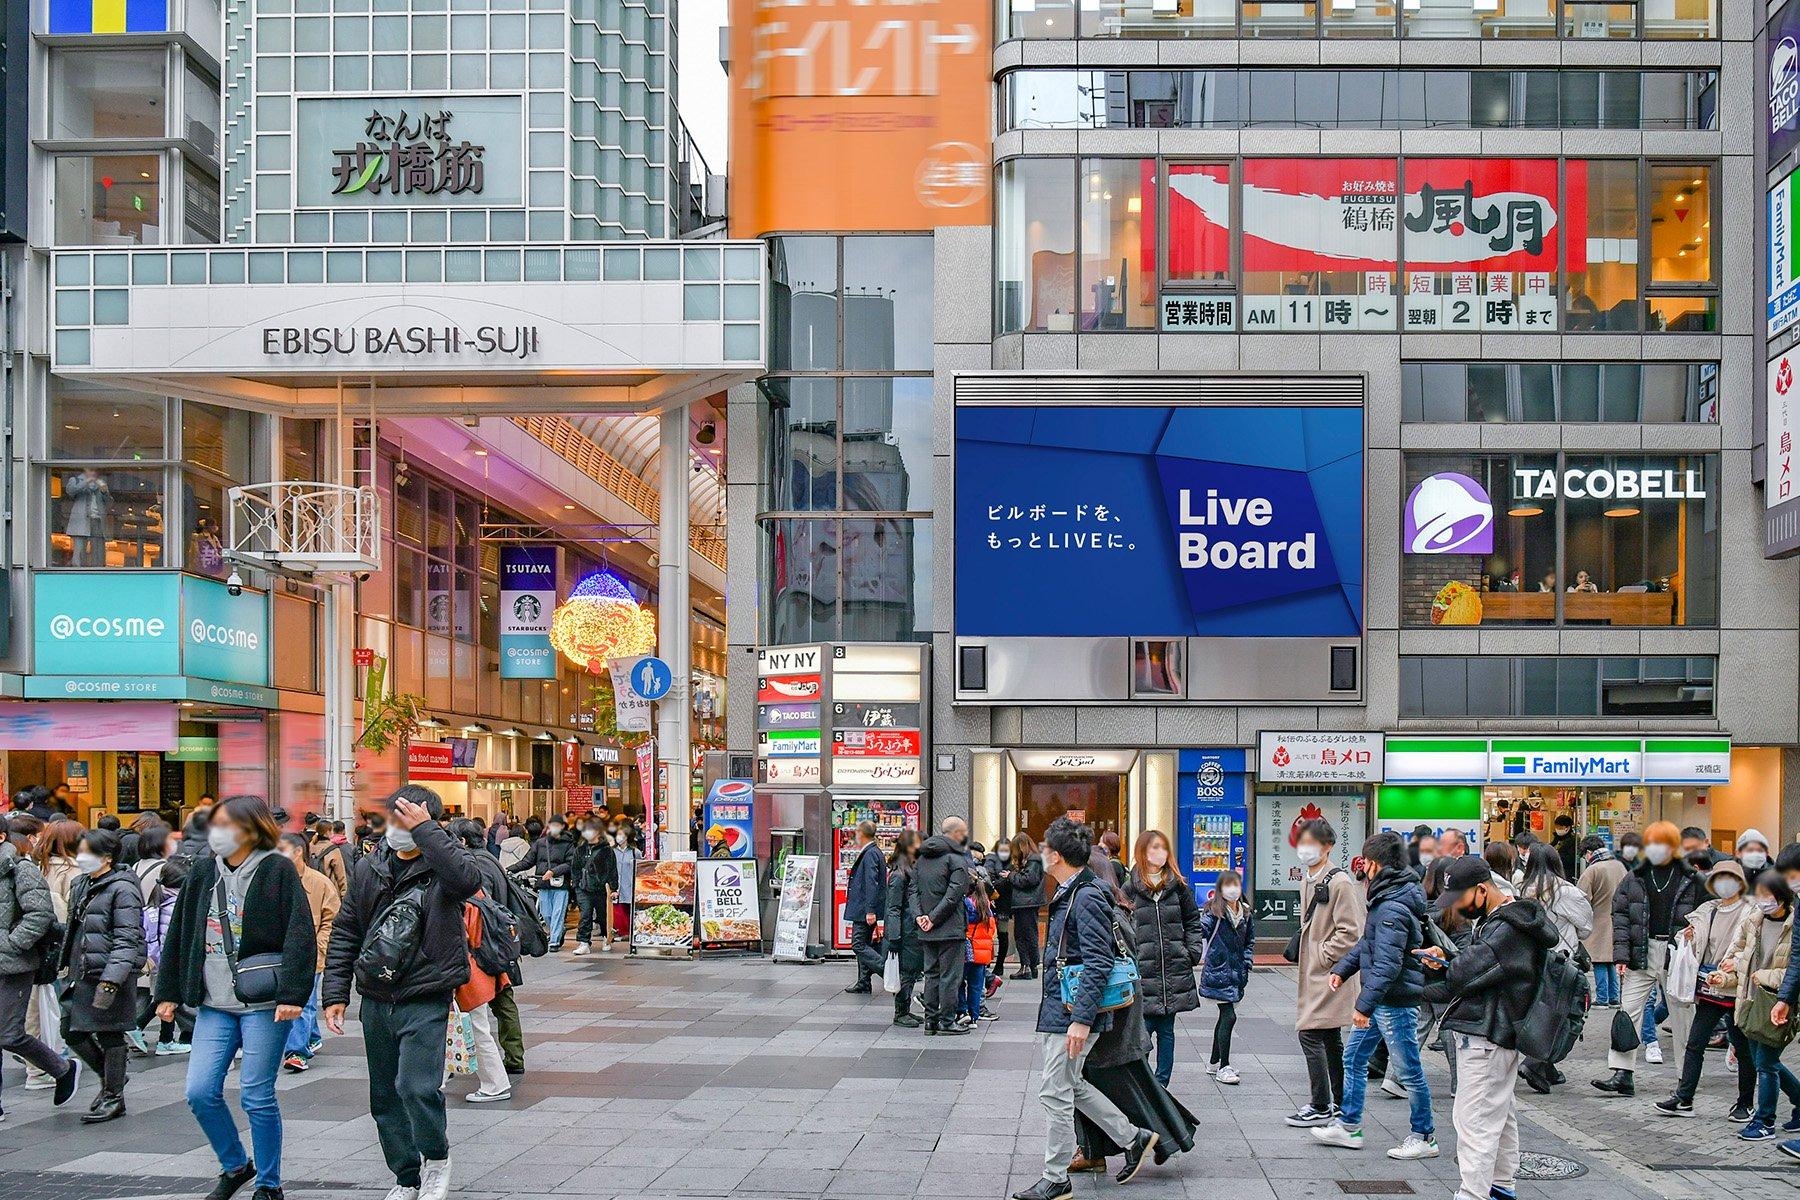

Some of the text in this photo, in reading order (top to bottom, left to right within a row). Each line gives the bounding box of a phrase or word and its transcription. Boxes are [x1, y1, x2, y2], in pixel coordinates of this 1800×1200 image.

[1769, 80, 1799, 116] TACO
[1772, 99, 1799, 134] BELL
[365, 109, 453, 141] なんば
[331, 141, 485, 195] 戎橋筋
[1341, 180, 1396, 193] お好み焼き
[1343, 195, 1393, 203] FUGETSU
[1341, 206, 1395, 232] 鶴橋
[1404, 179, 1543, 256] 風月
[1774, 189, 1785, 290] FamilyMart
[1165, 301, 1232, 326] 営業時間
[1247, 309, 1275, 324] AM
[263, 326, 538, 359] EBISU BASHI-SUJI
[987, 504, 1122, 522] ビルボードを、
[1179, 489, 1273, 526] Live
[986, 531, 1138, 550] もっとLIVEに。
[1179, 533, 1316, 569] Board
[506, 564, 551, 574] TSUTAYA
[50, 614, 165, 640] @cosme
[190, 618, 258, 650] @cosme
[507, 647, 549, 657] @cosme
[760, 651, 765, 659] 4
[835, 648, 843, 658] 8
[769, 652, 816, 669] NY NY
[65, 681, 157, 693] @cosme STORE
[760, 680, 766, 689] 3
[210, 685, 244, 699] @cosme
[782, 711, 816, 720] TACO BELL
[835, 706, 843, 714] 6
[761, 734, 766, 743] 1
[835, 732, 843, 742] 5
[772, 741, 817, 752] FamilyMart
[594, 747, 618, 761] TSUTAYA
[1320, 748, 1371, 766] 鳥メロ
[1201, 761, 1221, 769] COFFEE
[1533, 757, 1630, 776] FamilyMart
[1197, 786, 1224, 797] BOSS
[714, 889, 742, 897] TACO
[717, 897, 742, 905] BELL
[1262, 899, 1286, 911] 入口
